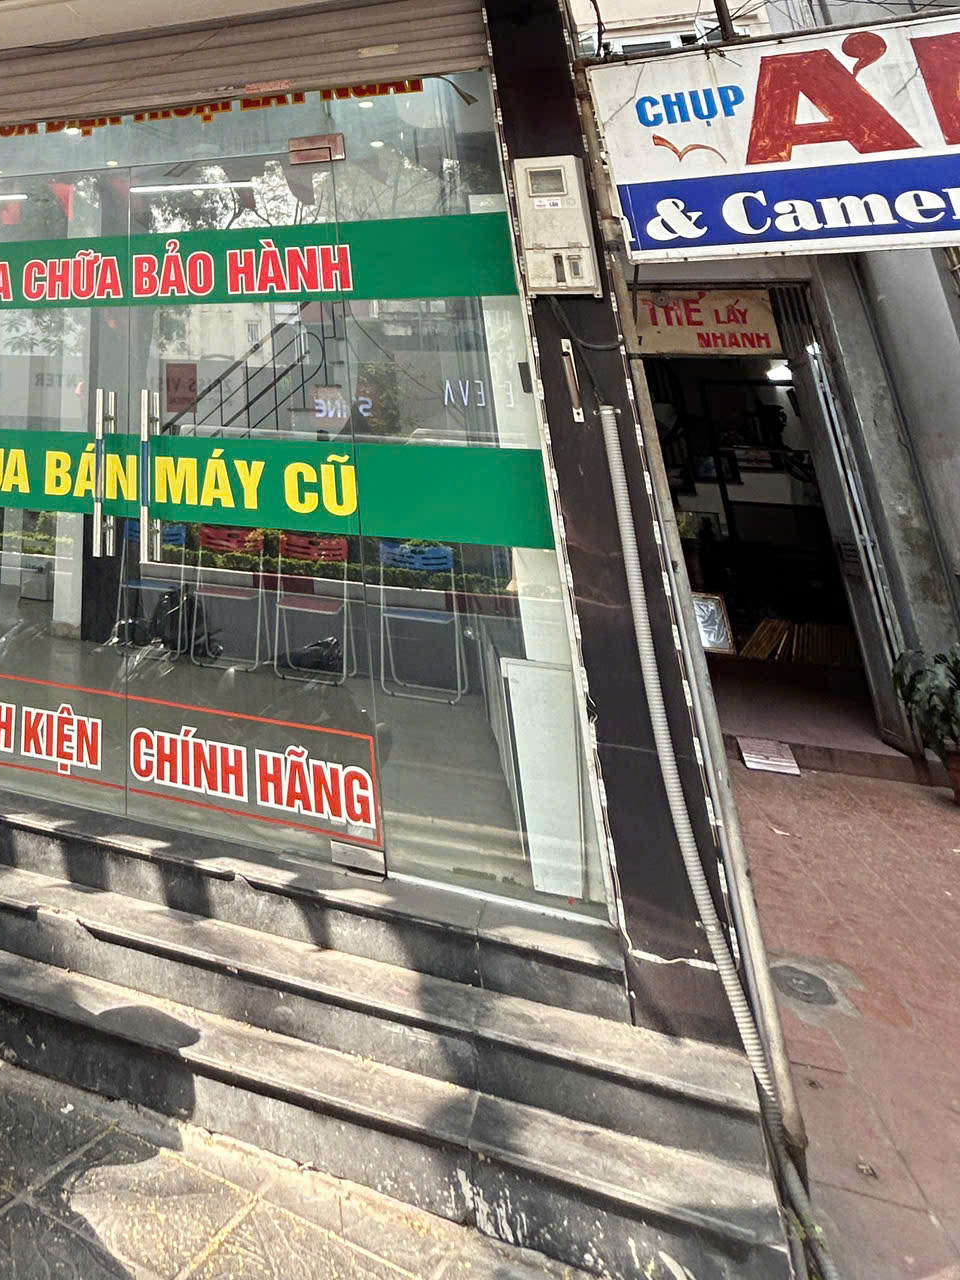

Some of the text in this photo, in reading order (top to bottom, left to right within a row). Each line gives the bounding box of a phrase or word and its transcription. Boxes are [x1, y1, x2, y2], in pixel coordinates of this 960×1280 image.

[634, 83, 745, 128] CHỤP
[646, 197, 708, 242] &
[21, 249, 122, 300] CHỮA
[131, 238, 215, 297] BẢO
[226, 239, 354, 295] HÀNH
[713, 298, 749, 325] LẤY
[695, 331, 773, 349] NHANH
[43, 442, 137, 515] BÁN
[155, 448, 265, 510] MÁY
[284, 455, 359, 517] CŨ
[22, 704, 102, 774] KIỆN
[130, 726, 248, 804] CHÍNH
[256, 746, 377, 830] HÃNG
